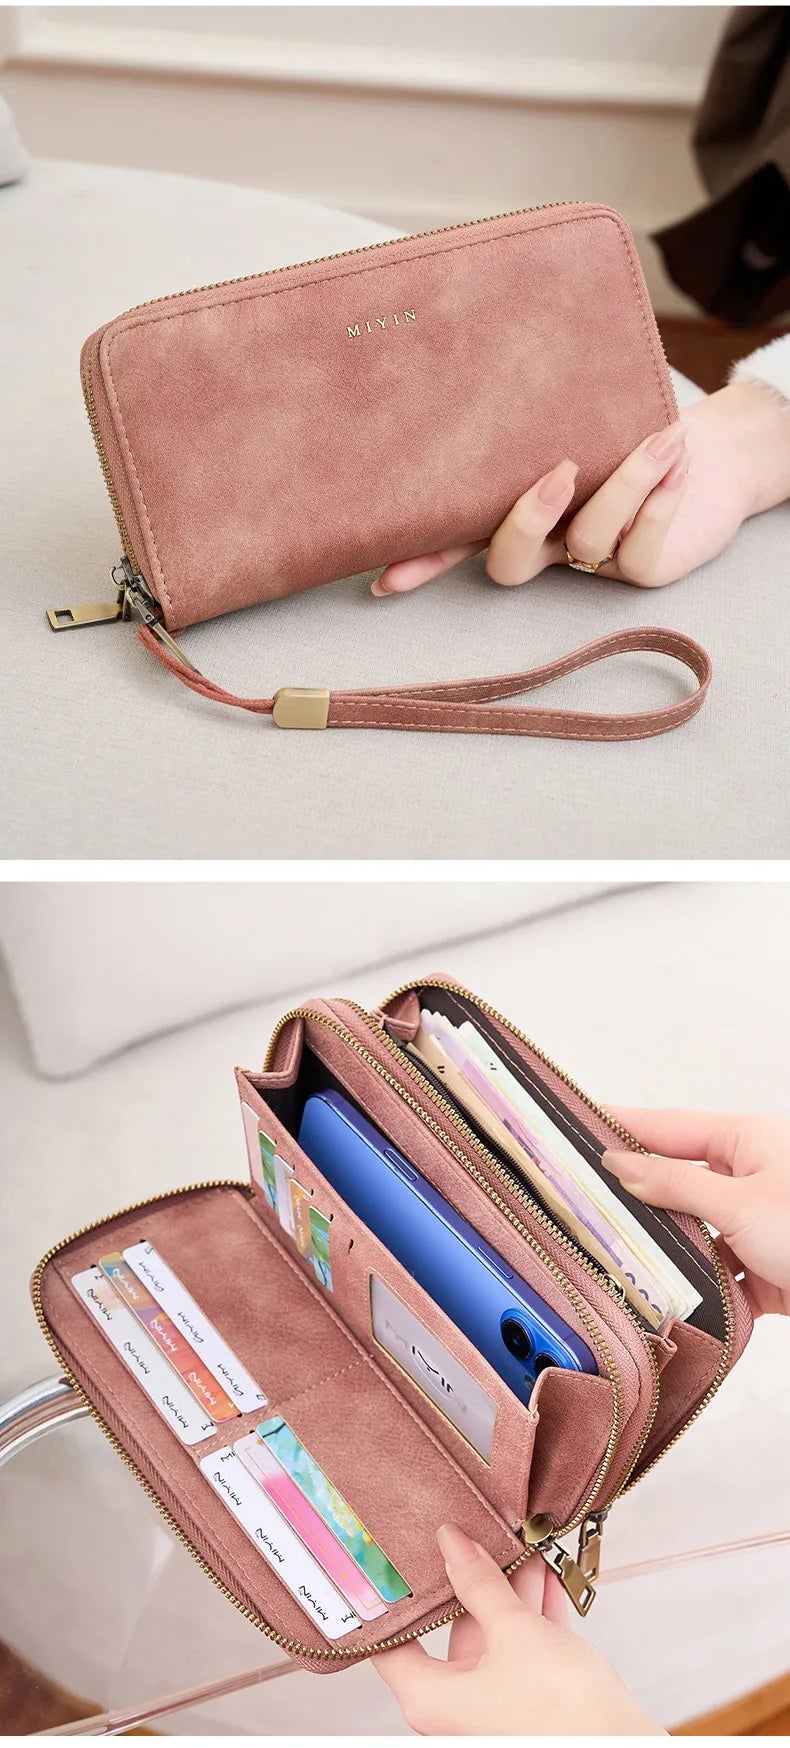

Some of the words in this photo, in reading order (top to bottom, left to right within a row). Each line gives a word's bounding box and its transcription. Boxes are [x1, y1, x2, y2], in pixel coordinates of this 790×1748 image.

[346, 310, 416, 338] MIYIN
[87, 1288, 112, 1320] MIYIN
[124, 1342, 150, 1374] MIYIN
[161, 1396, 188, 1428] MIYIN
[213, 1472, 242, 1505] MIYIN
[255, 1528, 285, 1562] MIYIN
[298, 1585, 329, 1620] MIYIN
